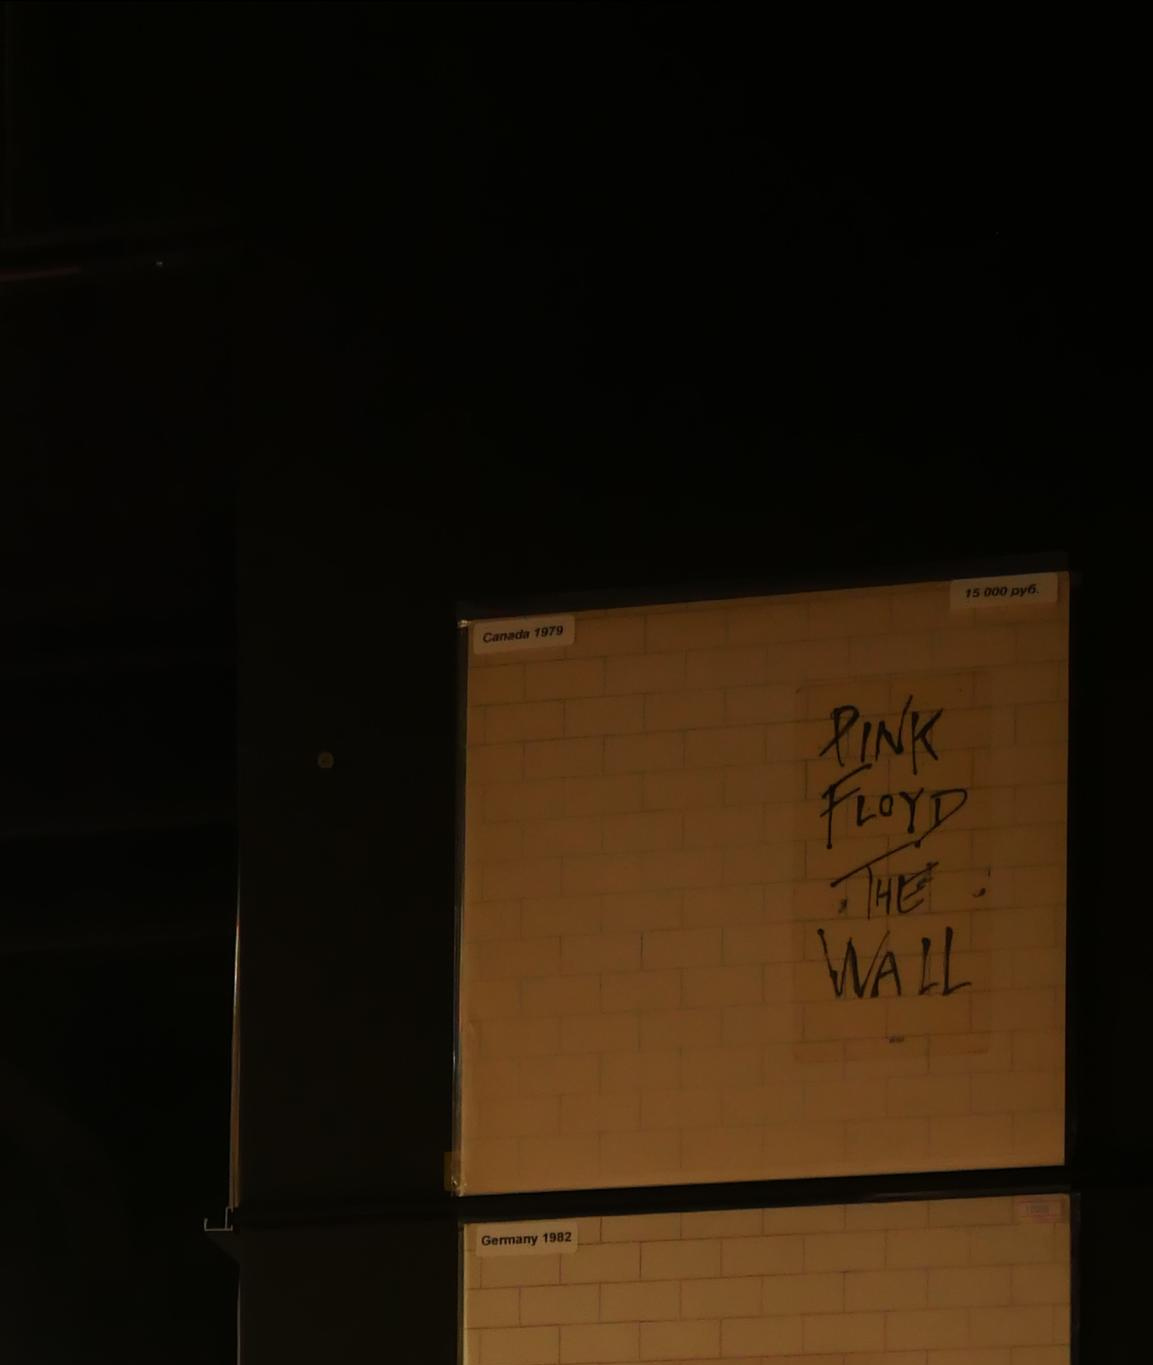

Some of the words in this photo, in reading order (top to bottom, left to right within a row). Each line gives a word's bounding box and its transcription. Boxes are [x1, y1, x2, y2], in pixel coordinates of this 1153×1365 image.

[966, 588, 980, 598] 15
[984, 586, 1008, 597] 000
[1010, 583, 1040, 597] руб.
[482, 629, 530, 643] Canada
[534, 625, 563, 638] 1979
[819, 695, 945, 775] PINK
[819, 763, 968, 850] FLOYD
[830, 845, 940, 920] THE
[817, 925, 971, 999] WALL
[481, 1235, 538, 1247] Germany
[543, 1232, 572, 1243] 1982
